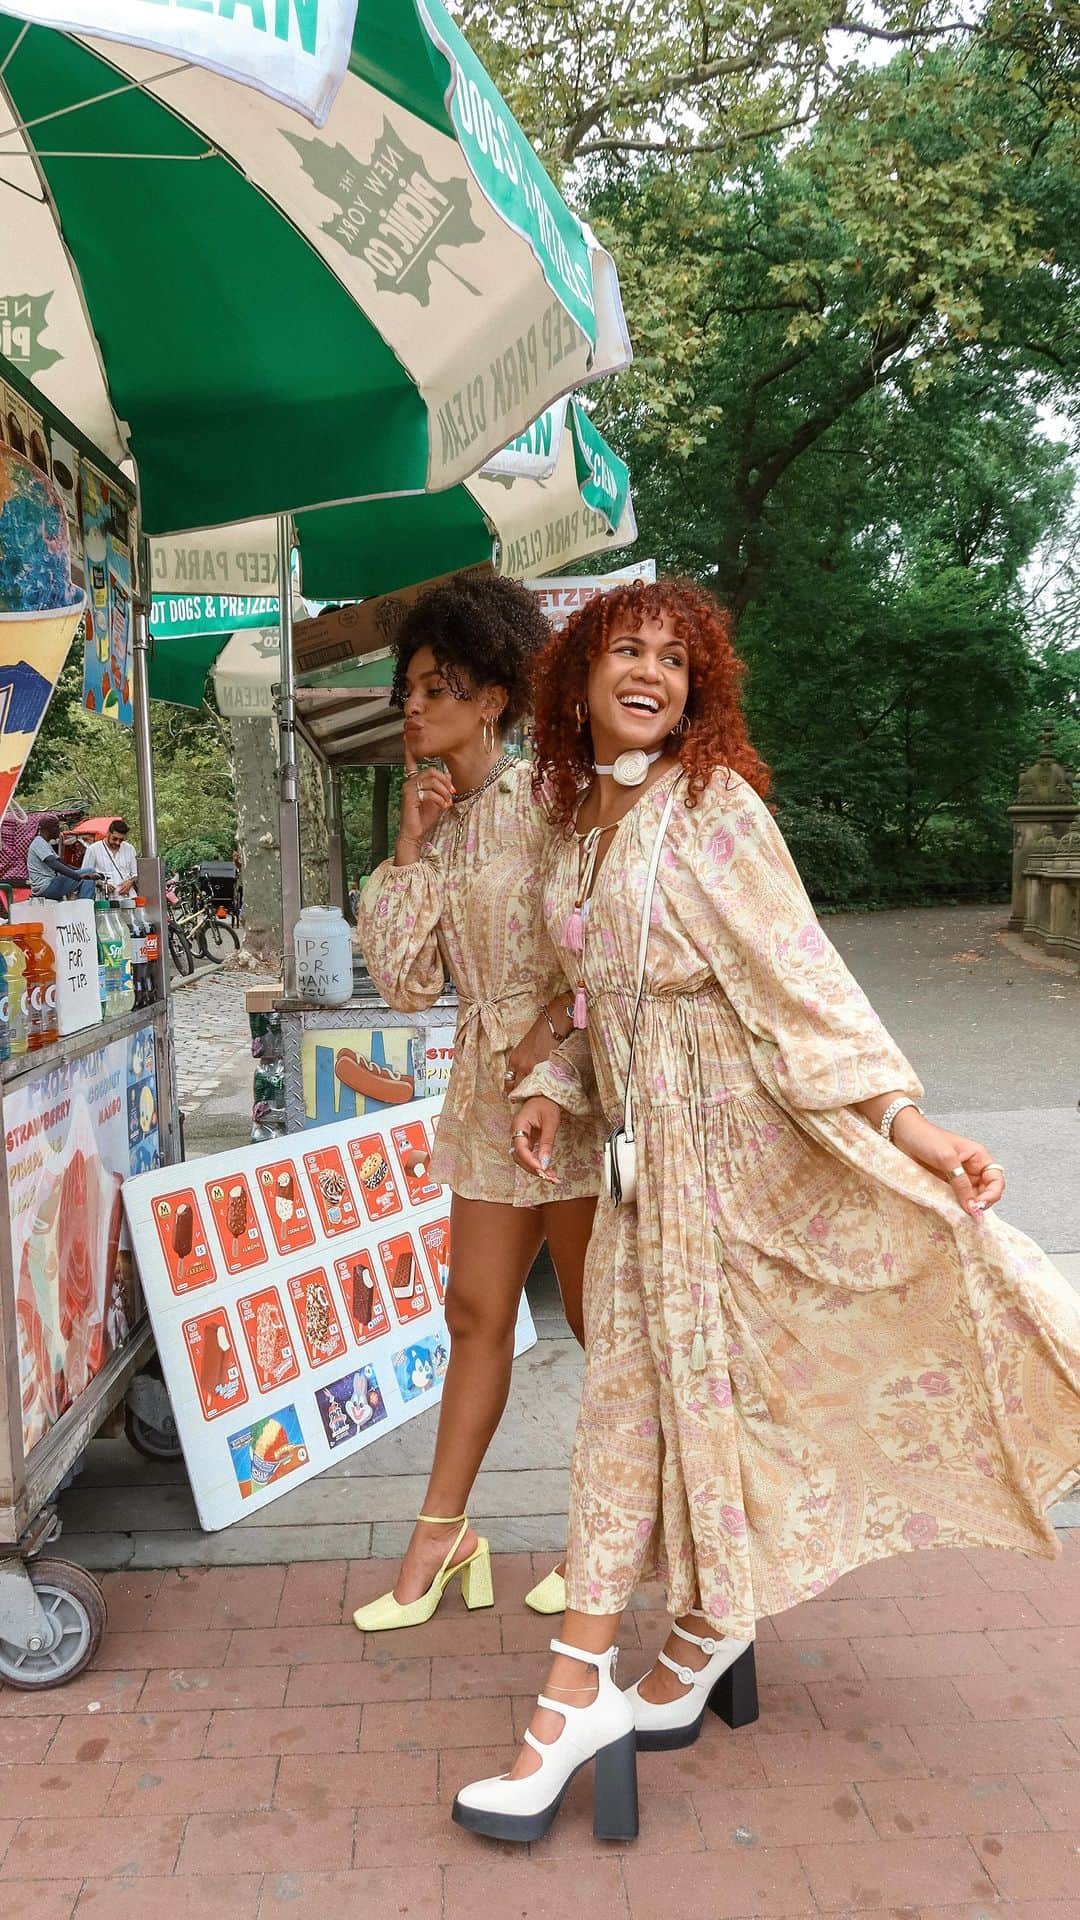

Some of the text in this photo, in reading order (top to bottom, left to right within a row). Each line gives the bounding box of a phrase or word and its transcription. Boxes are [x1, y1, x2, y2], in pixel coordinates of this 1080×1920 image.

[151, 600, 169, 624] OT
[169, 597, 201, 622] DOGS
[205, 595, 216, 618] &
[56, 922, 91, 946] THANKS
[297, 939, 330, 957] IPS
[68, 949, 84, 970] FOR
[299, 959, 326, 974] OR
[68, 974, 88, 992] TIPS
[298, 974, 340, 987] HANK
[6, 1099, 71, 1152] STRAWBERRY
